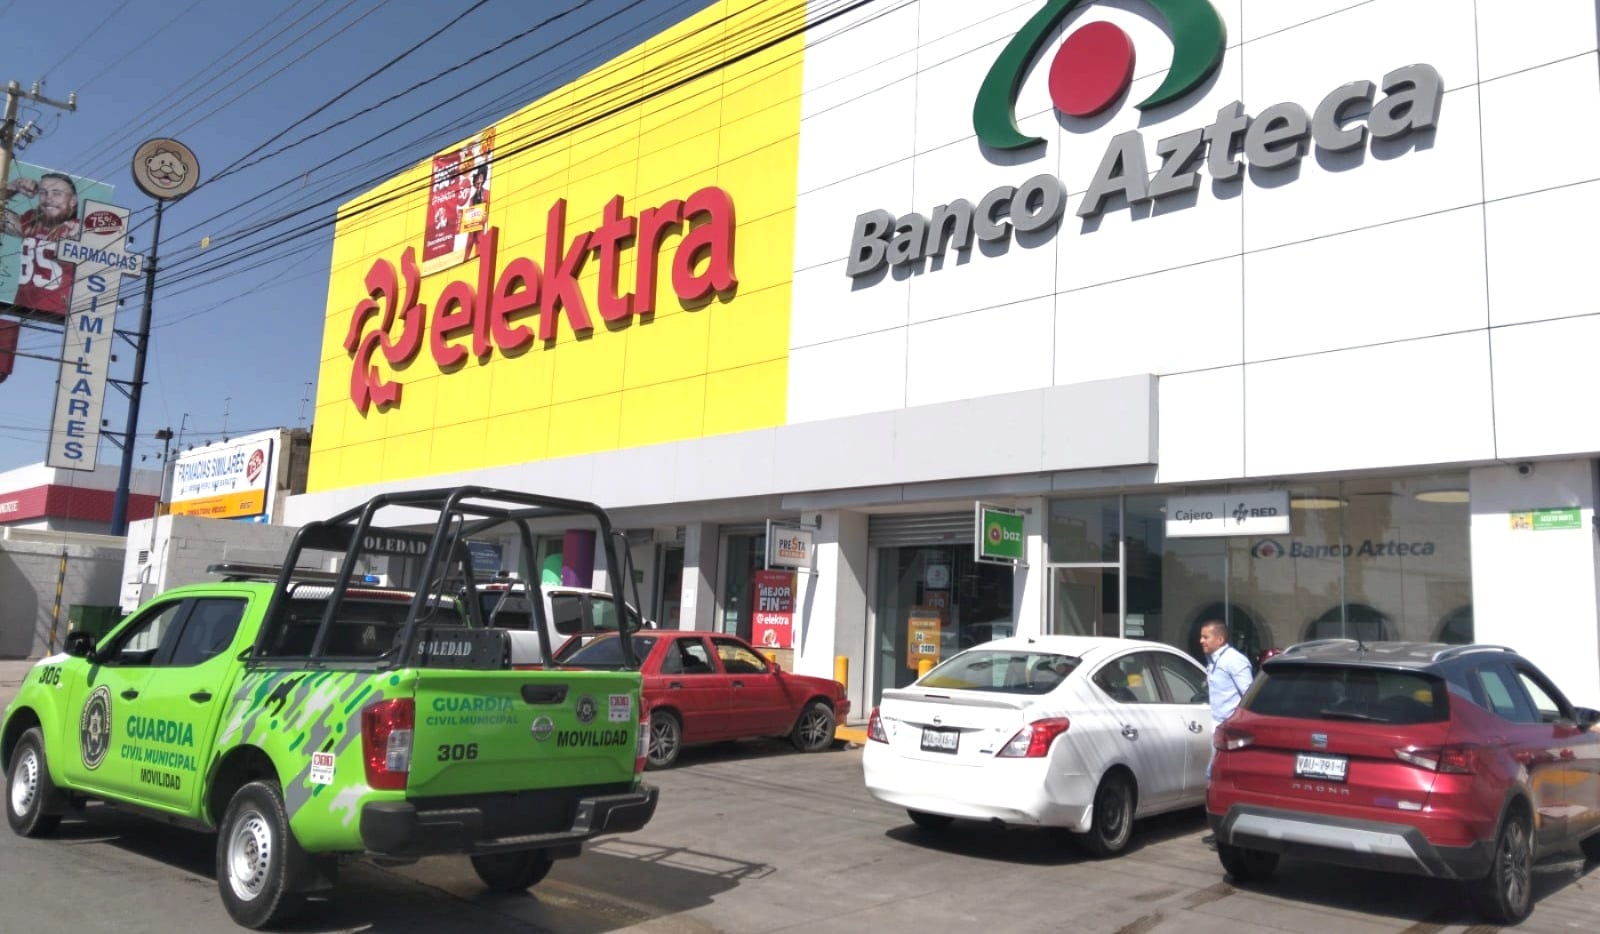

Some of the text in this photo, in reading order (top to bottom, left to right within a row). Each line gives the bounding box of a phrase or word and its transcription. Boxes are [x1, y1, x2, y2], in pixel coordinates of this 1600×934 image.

[845, 62, 1445, 279] Banco Azteca
[63, 243, 137, 270] FARMACIAS
[430, 185, 739, 367] elektra
[179, 459, 210, 480] FARMACIAS
[1175, 509, 1213, 523] Cajero
[1251, 507, 1277, 518] RED
[1003, 527, 1020, 542] baz
[363, 536, 427, 555] OLEDAD
[1290, 539, 1436, 558] Banco Azteca
[760, 586, 790, 597] MEJOR
[759, 597, 779, 611] FIN
[764, 613, 789, 625] elektra
[38, 666, 62, 686] 306
[432, 696, 515, 712] GUARDIA
[426, 715, 519, 726] CIVIL MUNICIPAL
[127, 715, 194, 748] GUARDIA
[556, 730, 628, 747] MOVILIDAD
[121, 744, 197, 772] CIVIL MUNICIPAL
[437, 743, 478, 762] 306
[141, 768, 181, 790] MOVILIDAD
